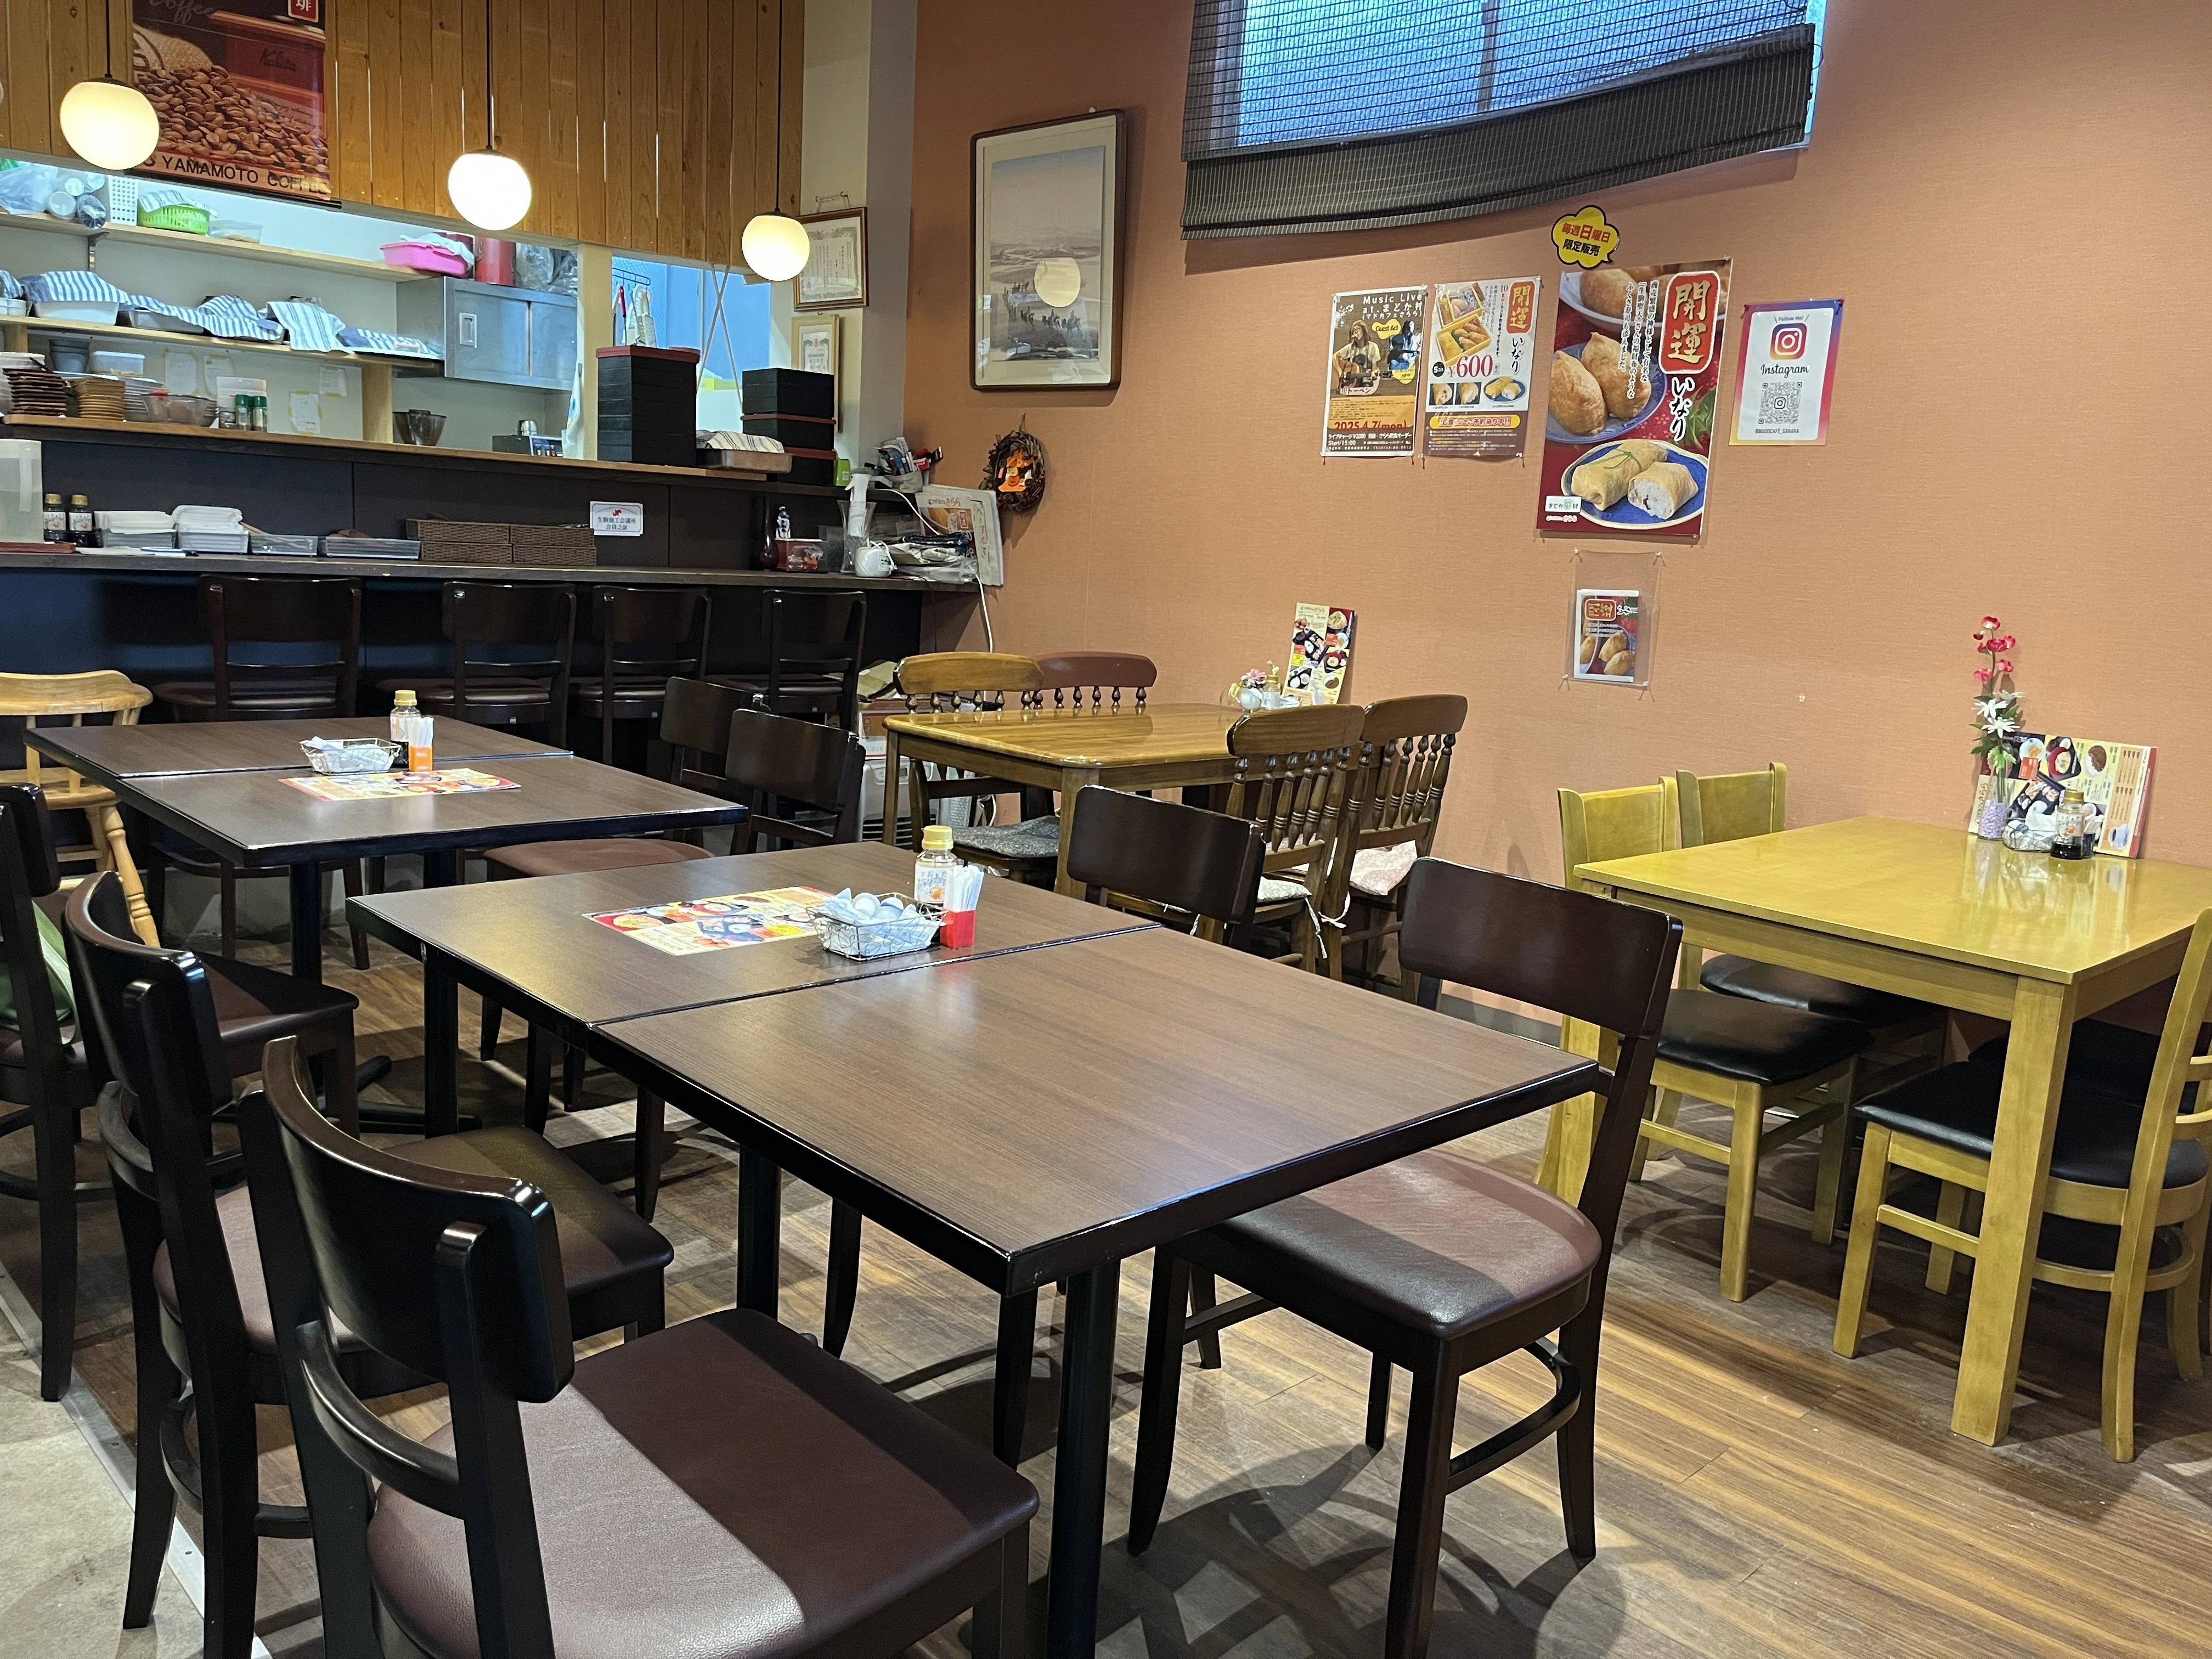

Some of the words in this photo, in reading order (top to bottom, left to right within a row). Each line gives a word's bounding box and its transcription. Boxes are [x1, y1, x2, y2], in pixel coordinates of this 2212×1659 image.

[162, 155, 258, 183] YAMAMOTO
[1562, 222, 1611, 243] 毎週日曜日
[1562, 238, 1600, 257] 限定販売
[1363, 295, 1394, 304] Music
[1400, 292, 1423, 302] Live
[1509, 285, 1531, 329] 開運
[1668, 280, 1711, 364] 開運
[1511, 337, 1525, 375] いなり
[1760, 364, 1809, 378] Instagram
[1671, 377, 1695, 441] いなり
